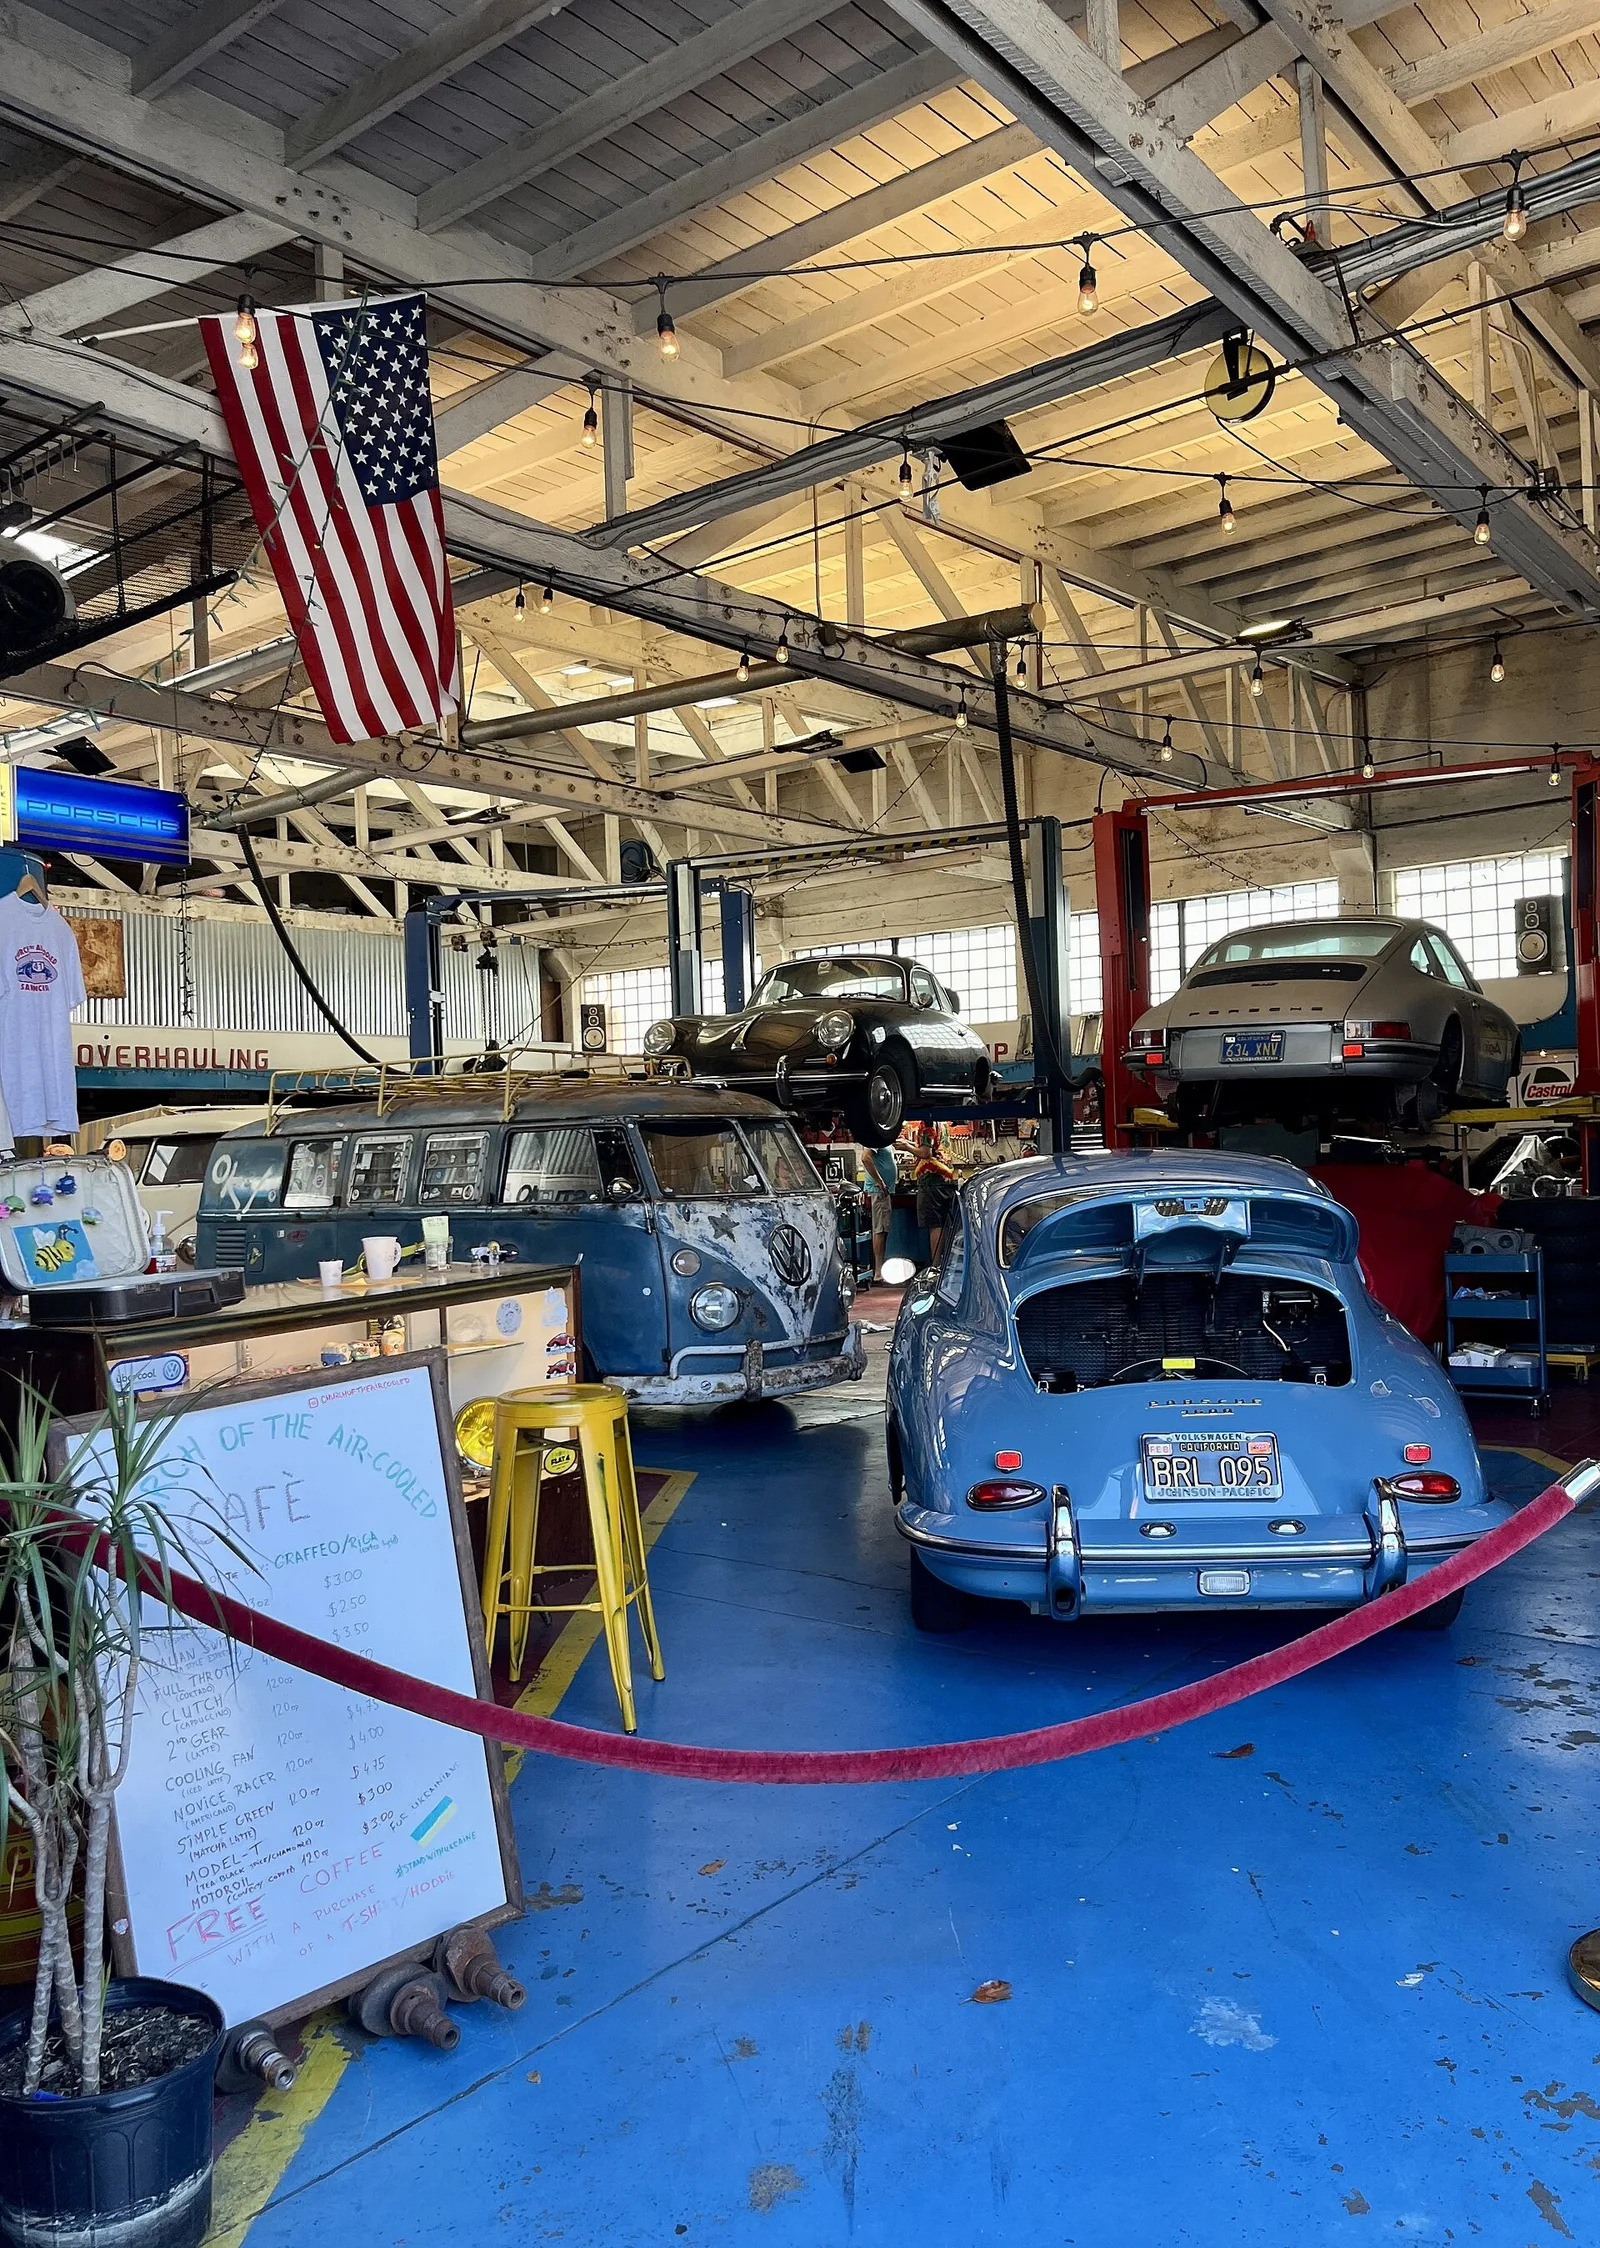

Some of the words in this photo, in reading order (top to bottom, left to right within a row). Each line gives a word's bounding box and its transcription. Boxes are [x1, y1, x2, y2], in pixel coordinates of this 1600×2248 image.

[27, 800, 180, 832] PORSCHE
[78, 1045, 268, 1070] OVERHAULING
[1226, 1044, 1248, 1057] 634
[1255, 1043, 1278, 1056] XNV
[219, 1422, 254, 1451] OF
[263, 1413, 314, 1440] THE
[1180, 1442, 1240, 1452] CALIFORNIA
[1152, 1457, 1213, 1487] BRL
[1219, 1457, 1272, 1487] 095
[324, 1569, 363, 1589] $3.00
[326, 1594, 367, 1618] $2.50
[332, 1621, 370, 1643] $3.50
[161, 1695, 223, 1726] CLUTCH
[190, 1726, 230, 1749] GEAR
[165, 1761, 226, 1792] COOLING
[233, 1744, 255, 1767] FAN
[233, 1771, 277, 1796] RACER
[235, 1801, 274, 1826] GREEN
[166, 1894, 267, 1962] FREE
[300, 1841, 385, 1894] COFFEE
[191, 1876, 255, 1911] MOTOROIL
[313, 1884, 376, 1921] PURCHASE
[299, 1942, 315, 1957] OF
